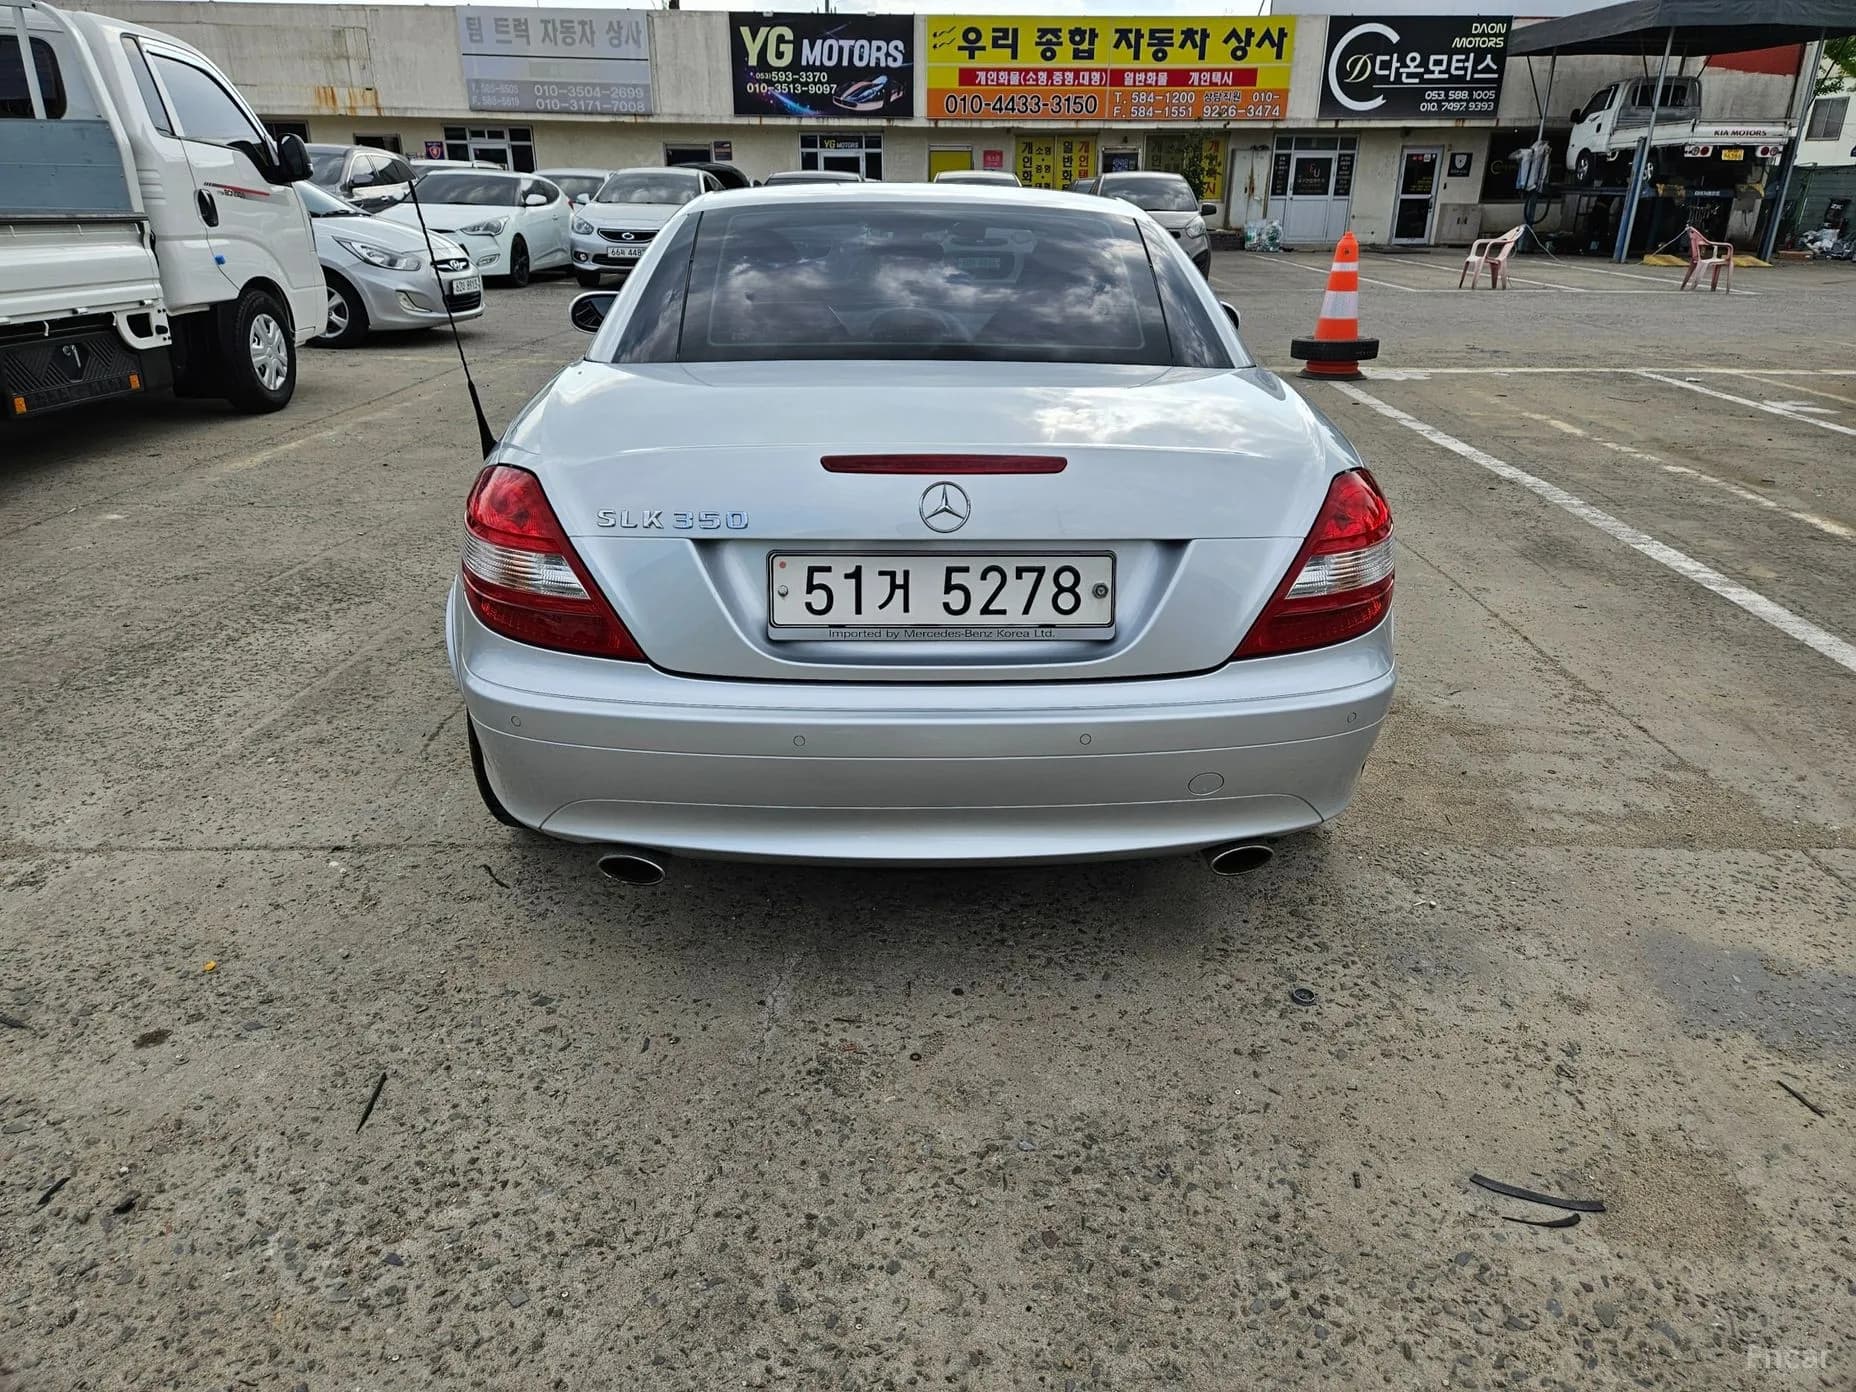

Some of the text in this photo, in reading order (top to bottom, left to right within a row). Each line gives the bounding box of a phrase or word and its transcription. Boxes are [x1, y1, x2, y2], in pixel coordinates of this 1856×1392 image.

[495, 17, 531, 46] 트럭
[539, 18, 596, 48] 자동차
[605, 20, 642, 49] 상사
[1472, 23, 1507, 34] DAON
[740, 26, 794, 67] YG
[957, 27, 1288, 62] 우리 종합 자동차 상사
[1451, 37, 1505, 48] MOTORS
[801, 39, 905, 67] MOTORS
[1374, 52, 1499, 83] 다온모터스
[1124, 71, 1169, 86] 일반화물
[1189, 71, 1233, 86] 개인택시
[534, 85, 645, 98] 010-3504-2699
[746, 83, 837, 94] 010-3513-9097
[536, 99, 645, 112] 010-3171-7008
[944, 94, 1098, 115] 010-4433-3150
[1131, 92, 1196, 104] 584-1200
[1130, 105, 1193, 117] 584-1551
[823, 139, 836, 149] YG
[1022, 141, 1033, 188] 개인화
[597, 509, 750, 530] SLK 350
[804, 565, 1082, 616] 51거 5278
[829, 628, 1056, 640] Imported by Mercedes-Benz Korea Ltd.
